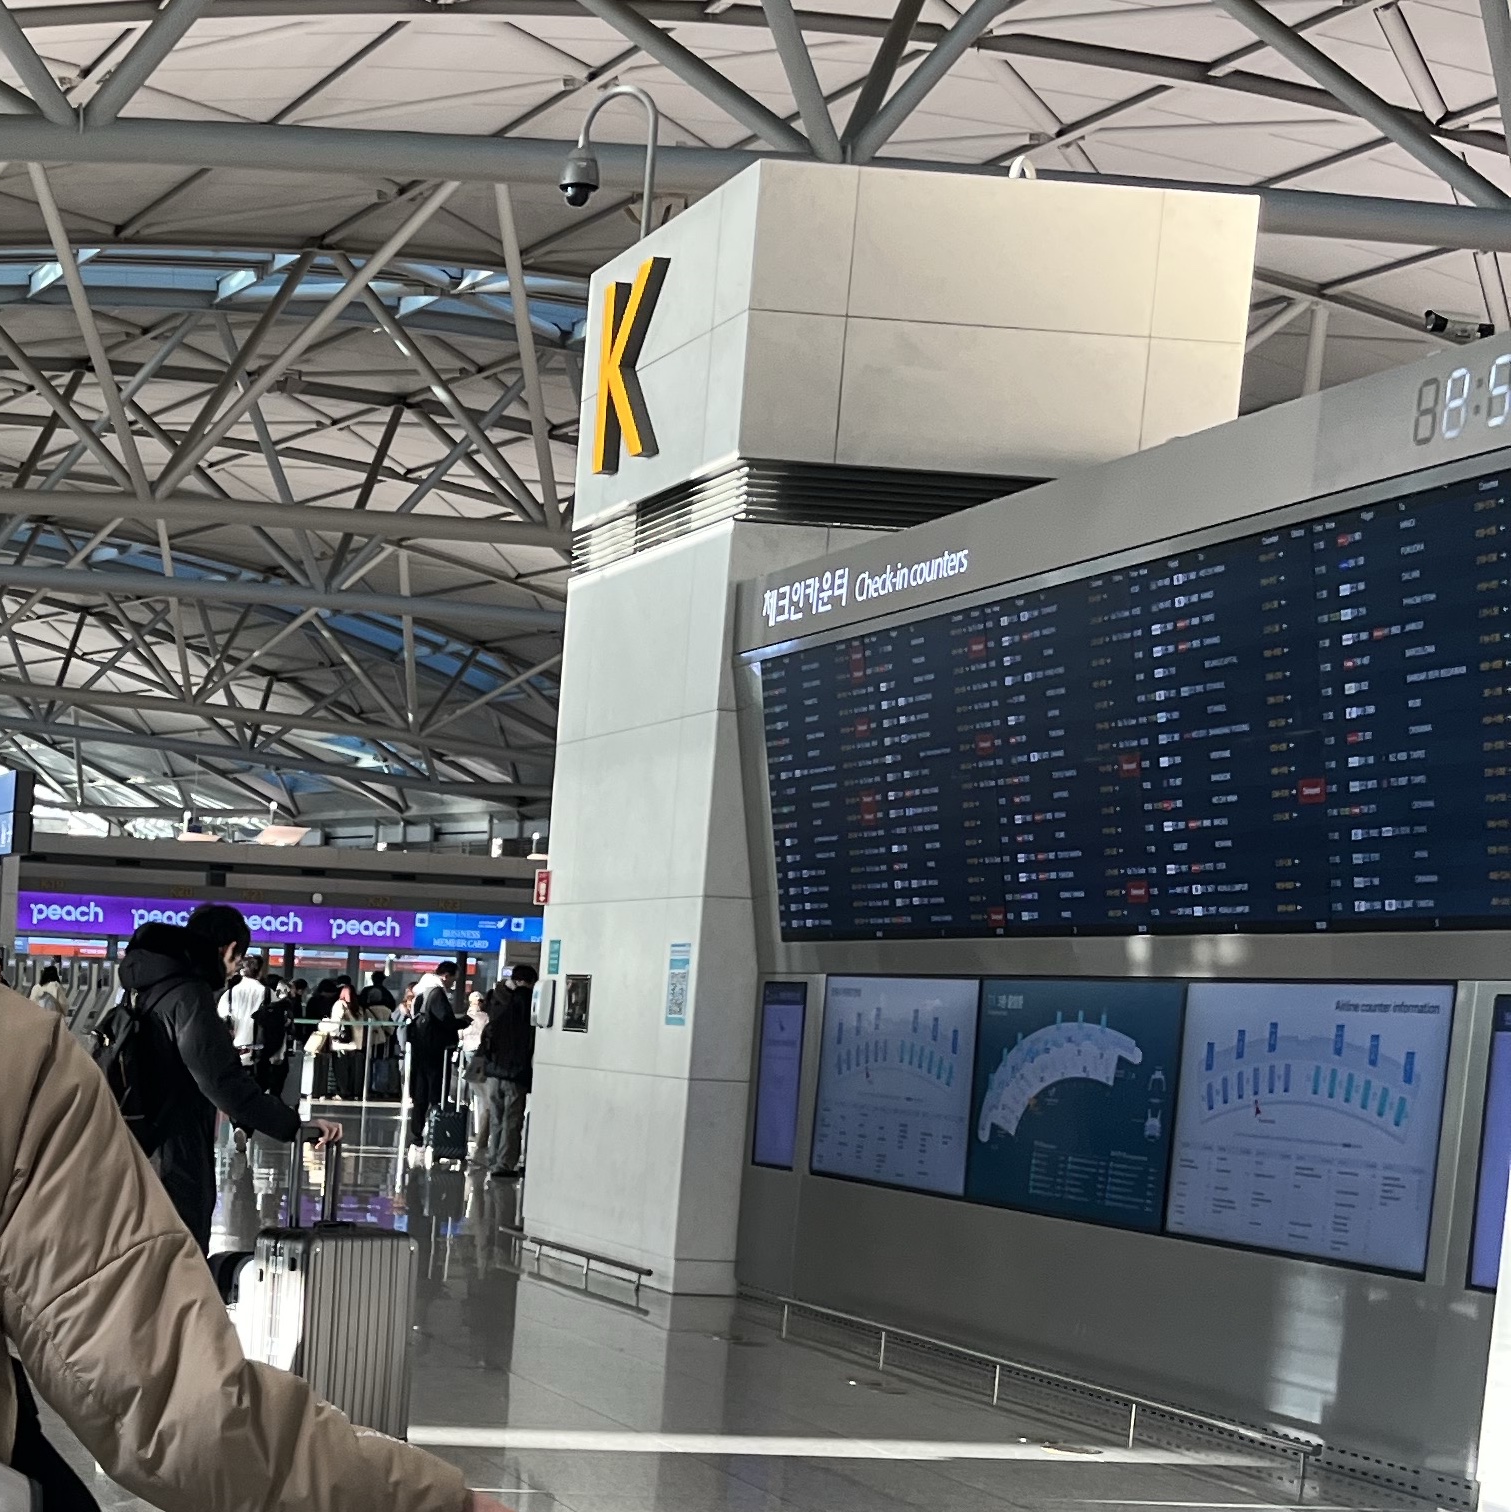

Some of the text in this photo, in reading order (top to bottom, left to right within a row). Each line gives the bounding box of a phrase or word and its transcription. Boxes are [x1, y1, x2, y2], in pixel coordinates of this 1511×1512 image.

[591, 256, 672, 476] K
[854, 562, 909, 602] Check-in
[909, 549, 969, 588] counters
[30, 902, 104, 924] peach
[131, 907, 196, 931] peac
[243, 911, 303, 933] each
[329, 917, 401, 939] peach
[442, 929, 481, 939] BUSINESS
[433, 938, 489, 949] MEMBER CARD
[1361, 1002, 1392, 1013] counter
[1393, 1001, 1440, 1014] information
